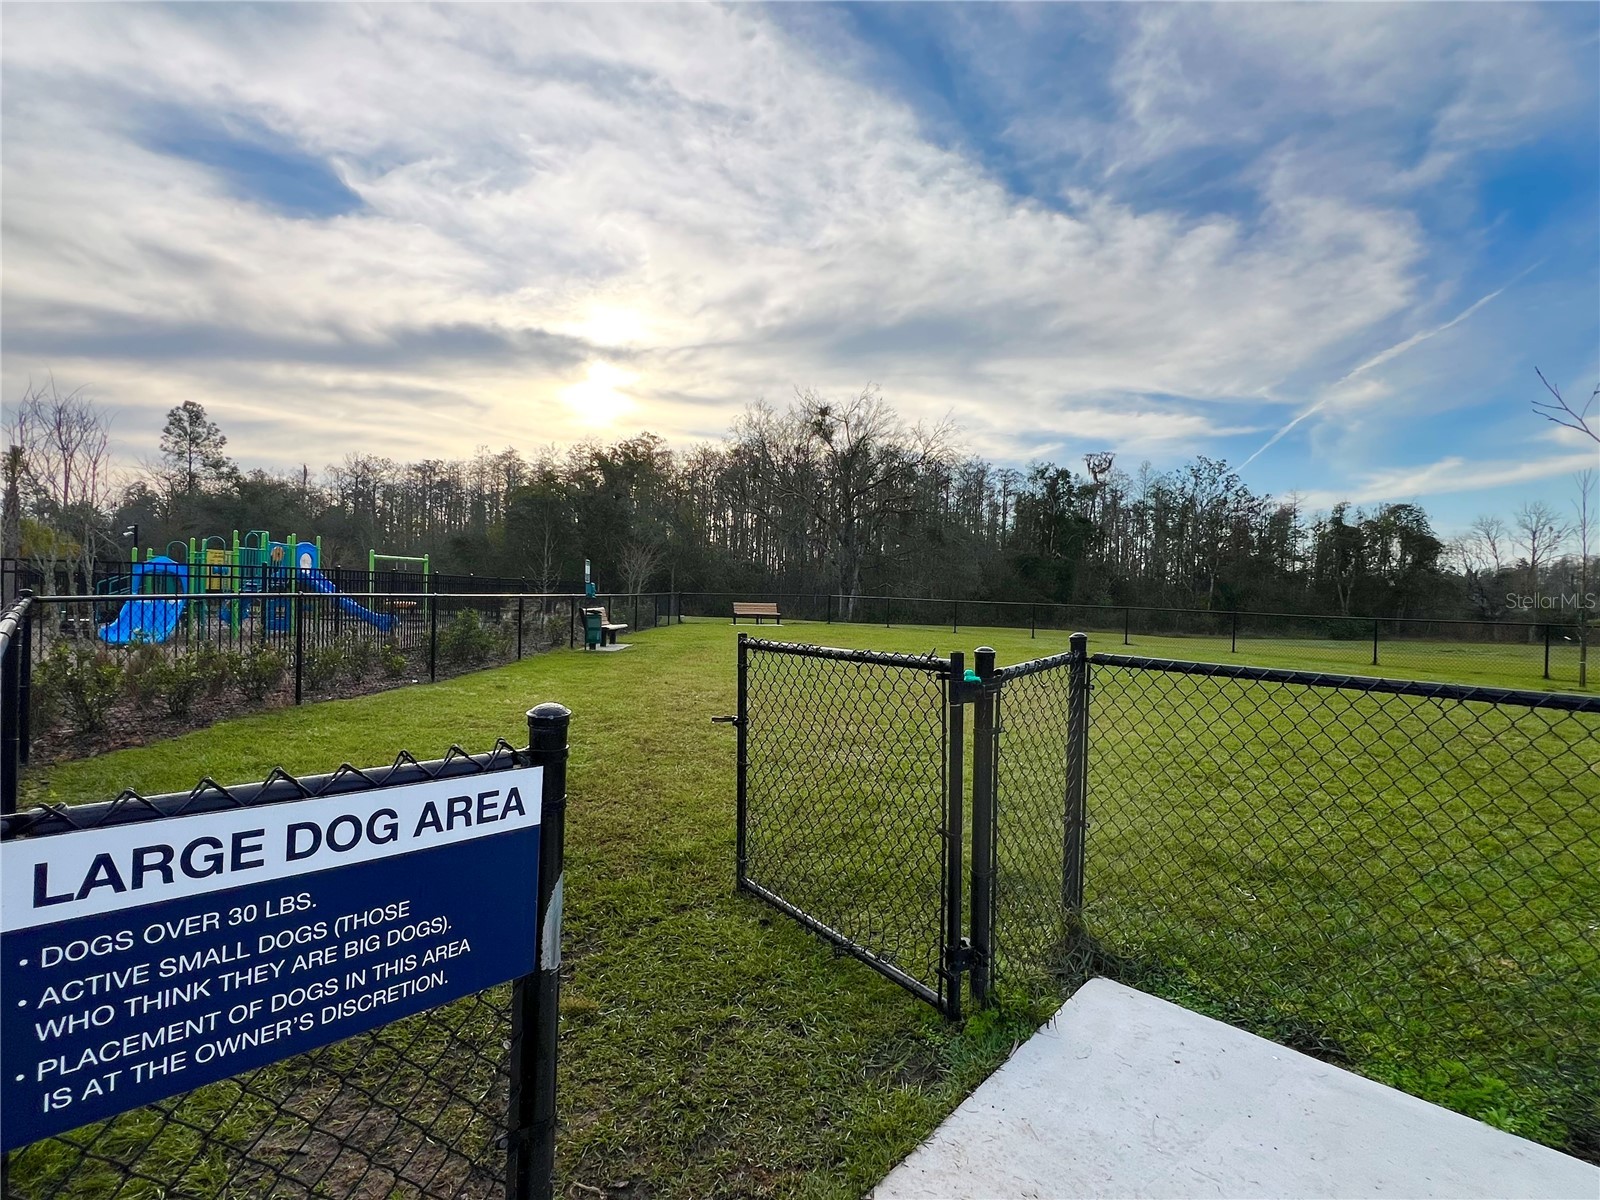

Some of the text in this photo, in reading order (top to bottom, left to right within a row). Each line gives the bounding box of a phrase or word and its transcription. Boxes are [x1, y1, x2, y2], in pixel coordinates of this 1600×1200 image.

[33, 787, 525, 908] LARGE DOG AREA
[35, 915, 452, 1042] WHO THINK THEY ARE BIG DOGS).
[37, 900, 411, 1009] ACTIVE SMALL DOGS (THOSE
[41, 892, 317, 968] DOGS OVER 30 LBS.
[37, 938, 472, 1082] PLACEMENT OF DOGS IN THIS AREA
[43, 970, 449, 1113] IS AT THE OWNER’S DISCRETION.
